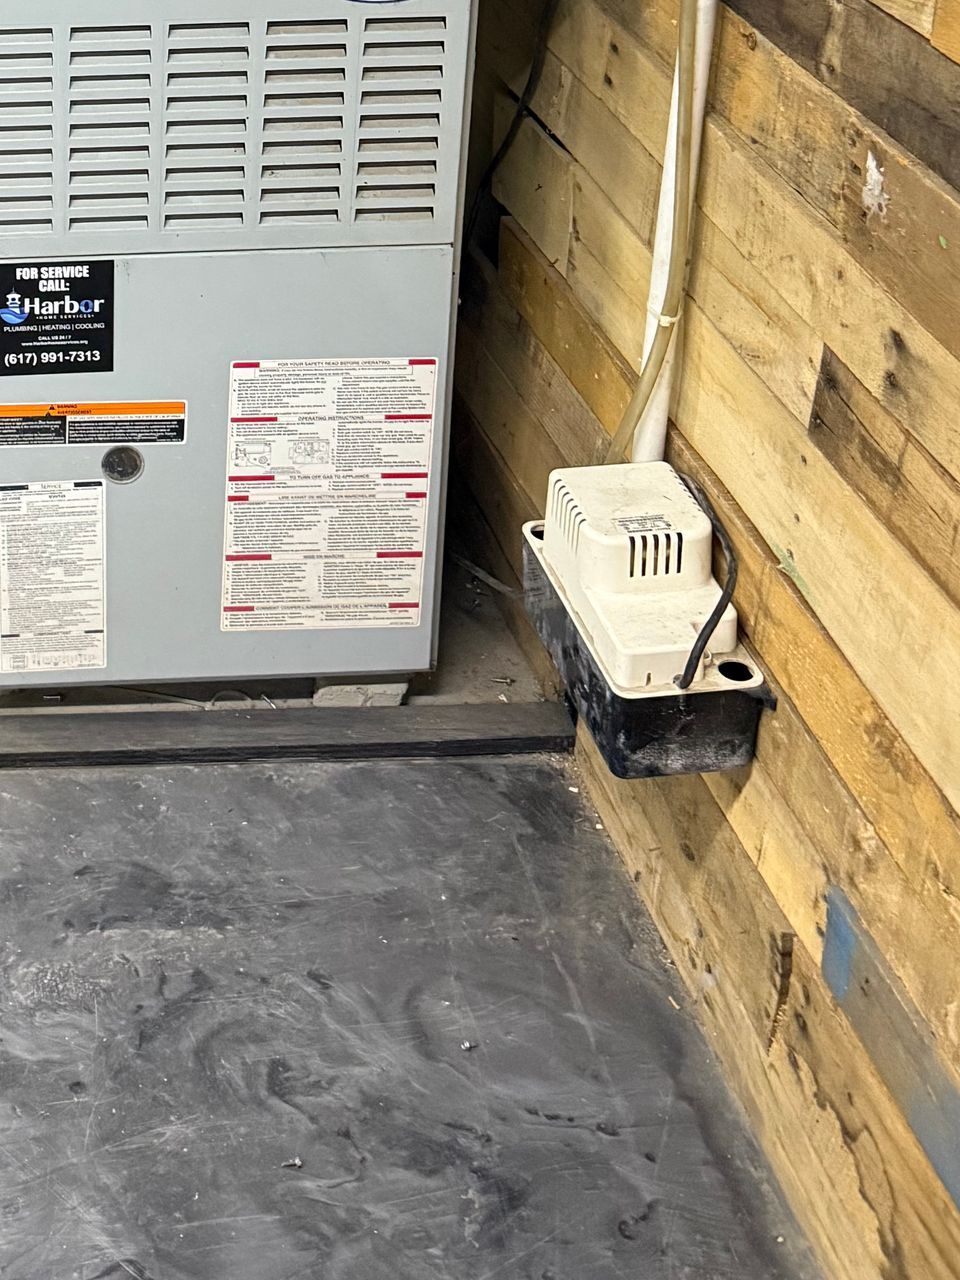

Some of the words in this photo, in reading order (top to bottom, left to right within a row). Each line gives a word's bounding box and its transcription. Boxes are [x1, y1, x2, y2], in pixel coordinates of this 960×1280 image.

[15, 267, 39, 280] FOR
[40, 265, 90, 279] SERVICE
[39, 279, 70, 292] CALL:
[24, 295, 105, 315] Harbor
[75, 322, 105, 330] COOLING
[4, 352, 37, 367] (617)
[40, 350, 101, 363] 991-7313
